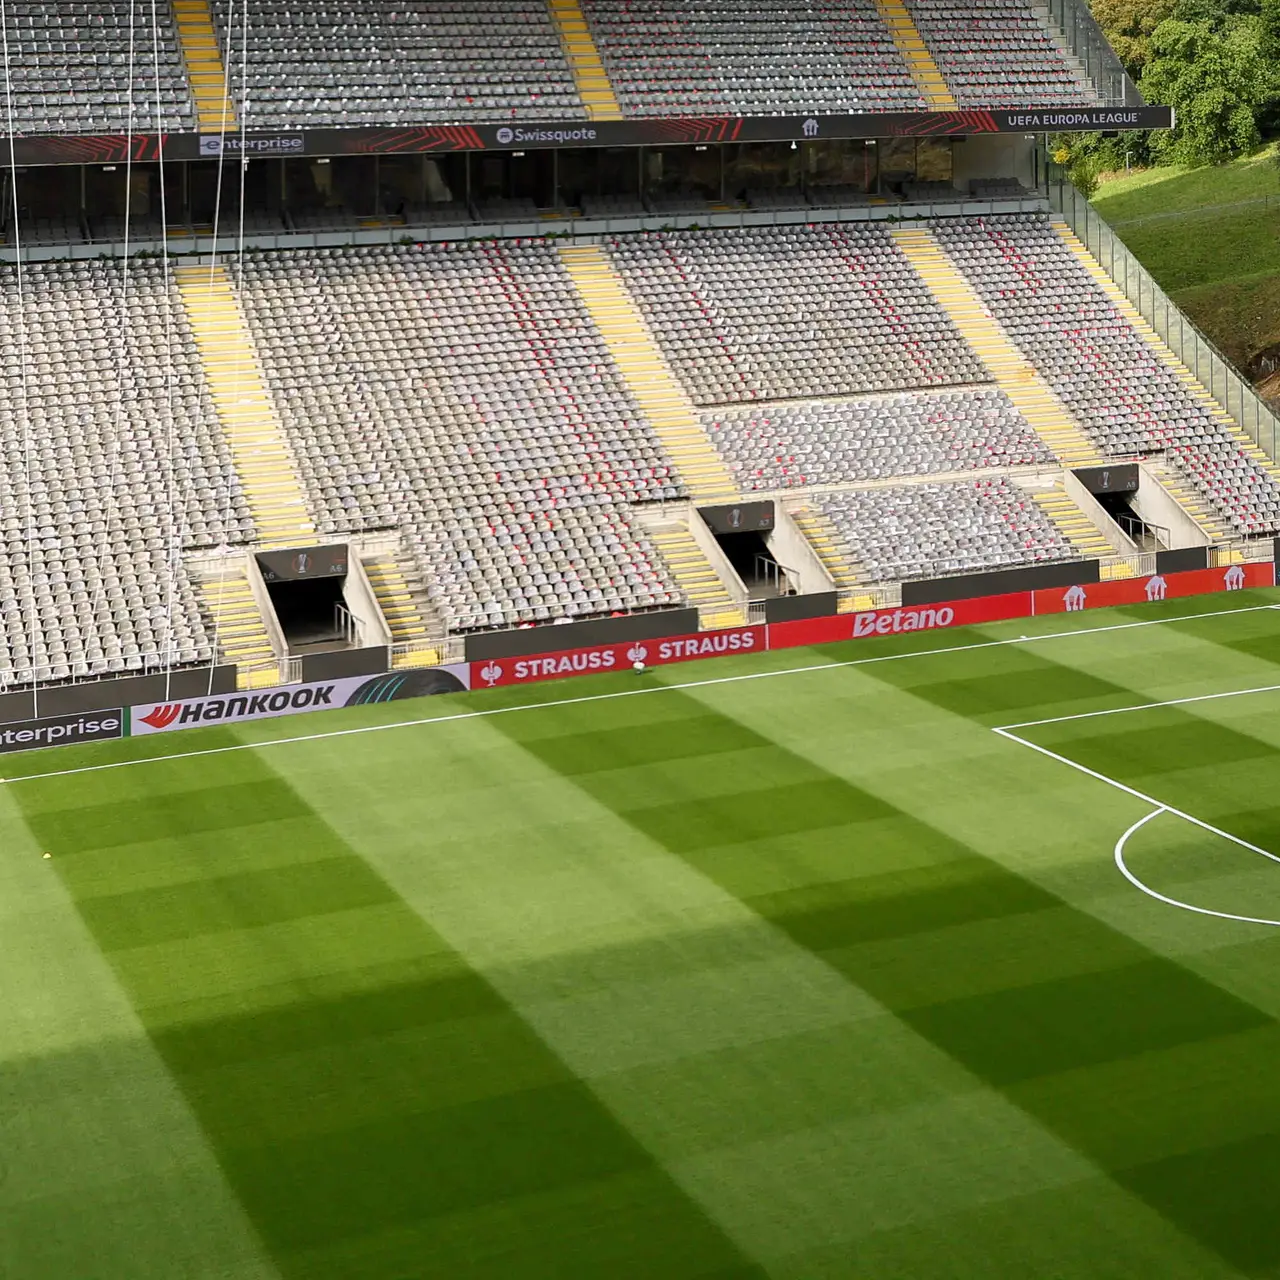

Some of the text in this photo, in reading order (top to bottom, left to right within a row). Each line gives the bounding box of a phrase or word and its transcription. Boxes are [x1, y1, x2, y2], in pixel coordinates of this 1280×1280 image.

[1008, 112, 1138, 126] UEFA EUROPA LEAGUE
[206, 136, 302, 151] enterprise
[514, 128, 596, 143] Swissquote
[852, 607, 955, 637] Betano
[514, 631, 755, 679] STRAUSS STRAUSS
[0, 719, 119, 744] terprise
